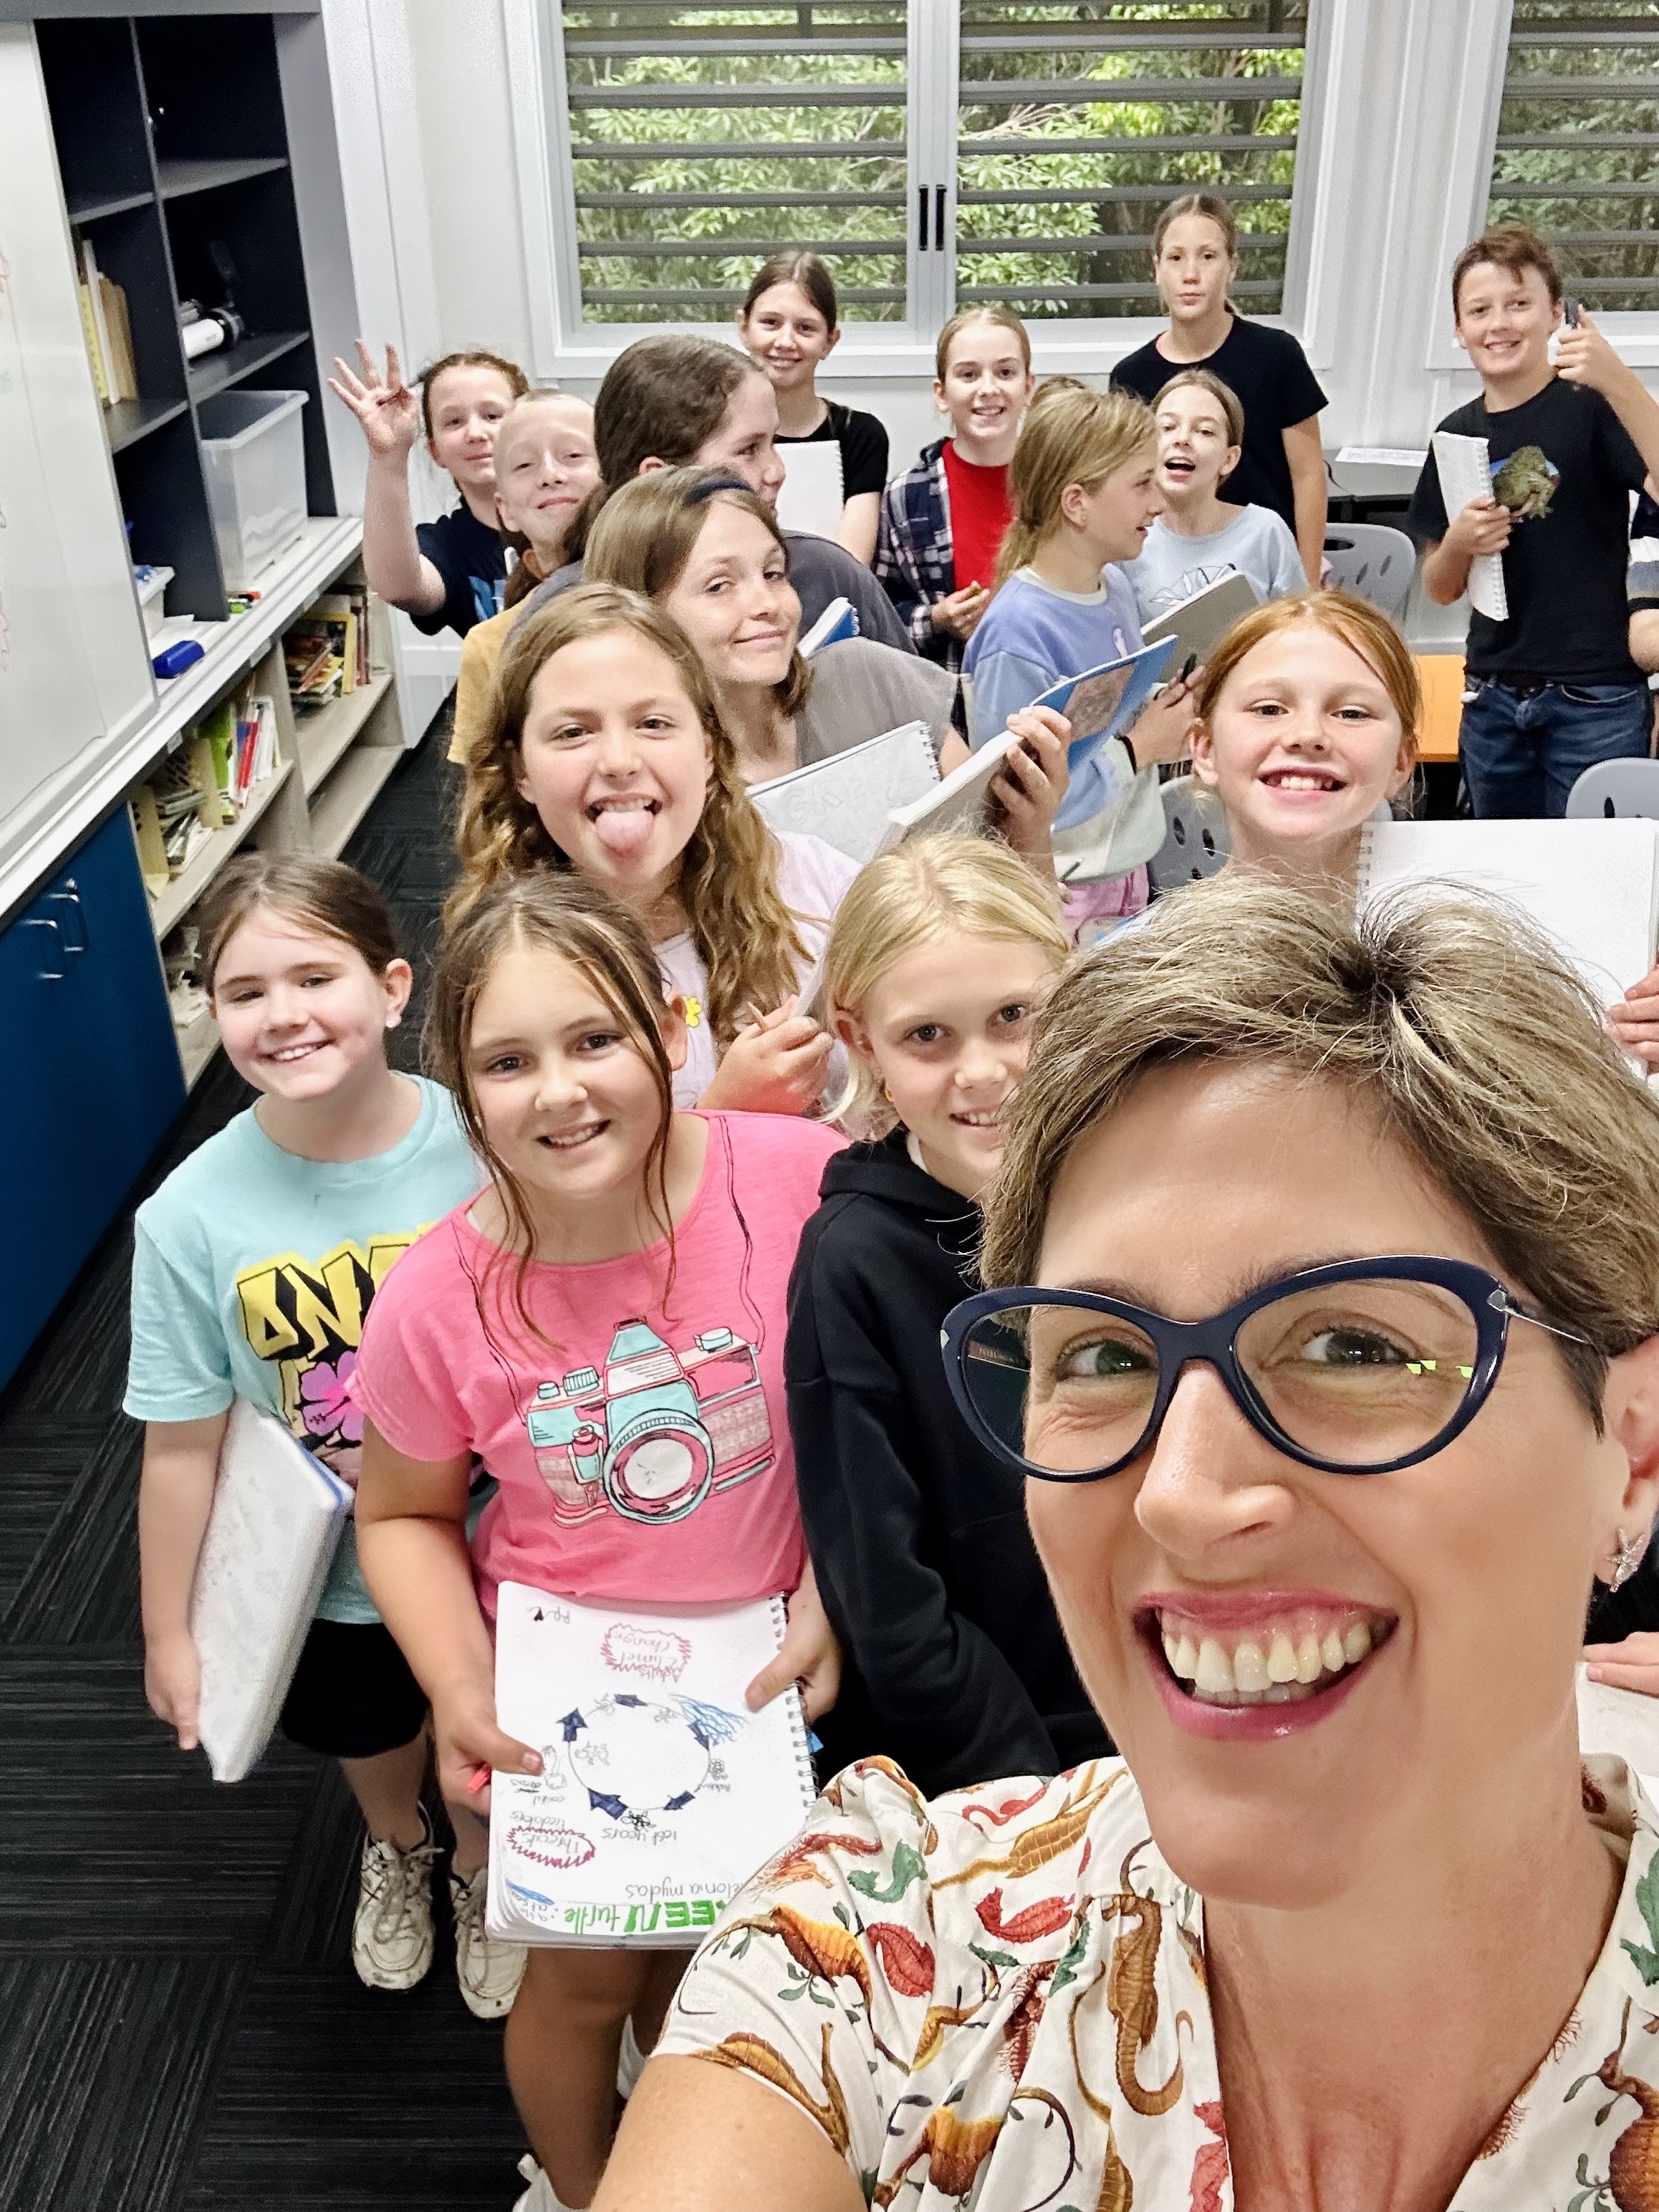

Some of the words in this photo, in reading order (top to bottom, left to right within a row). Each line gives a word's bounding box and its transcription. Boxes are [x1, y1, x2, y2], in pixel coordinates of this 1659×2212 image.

[625, 1877, 683, 1905] mydas
[690, 1882, 744, 1898] elonia
[563, 1904, 620, 1934] turtle
[623, 1900, 726, 1933] EEN
